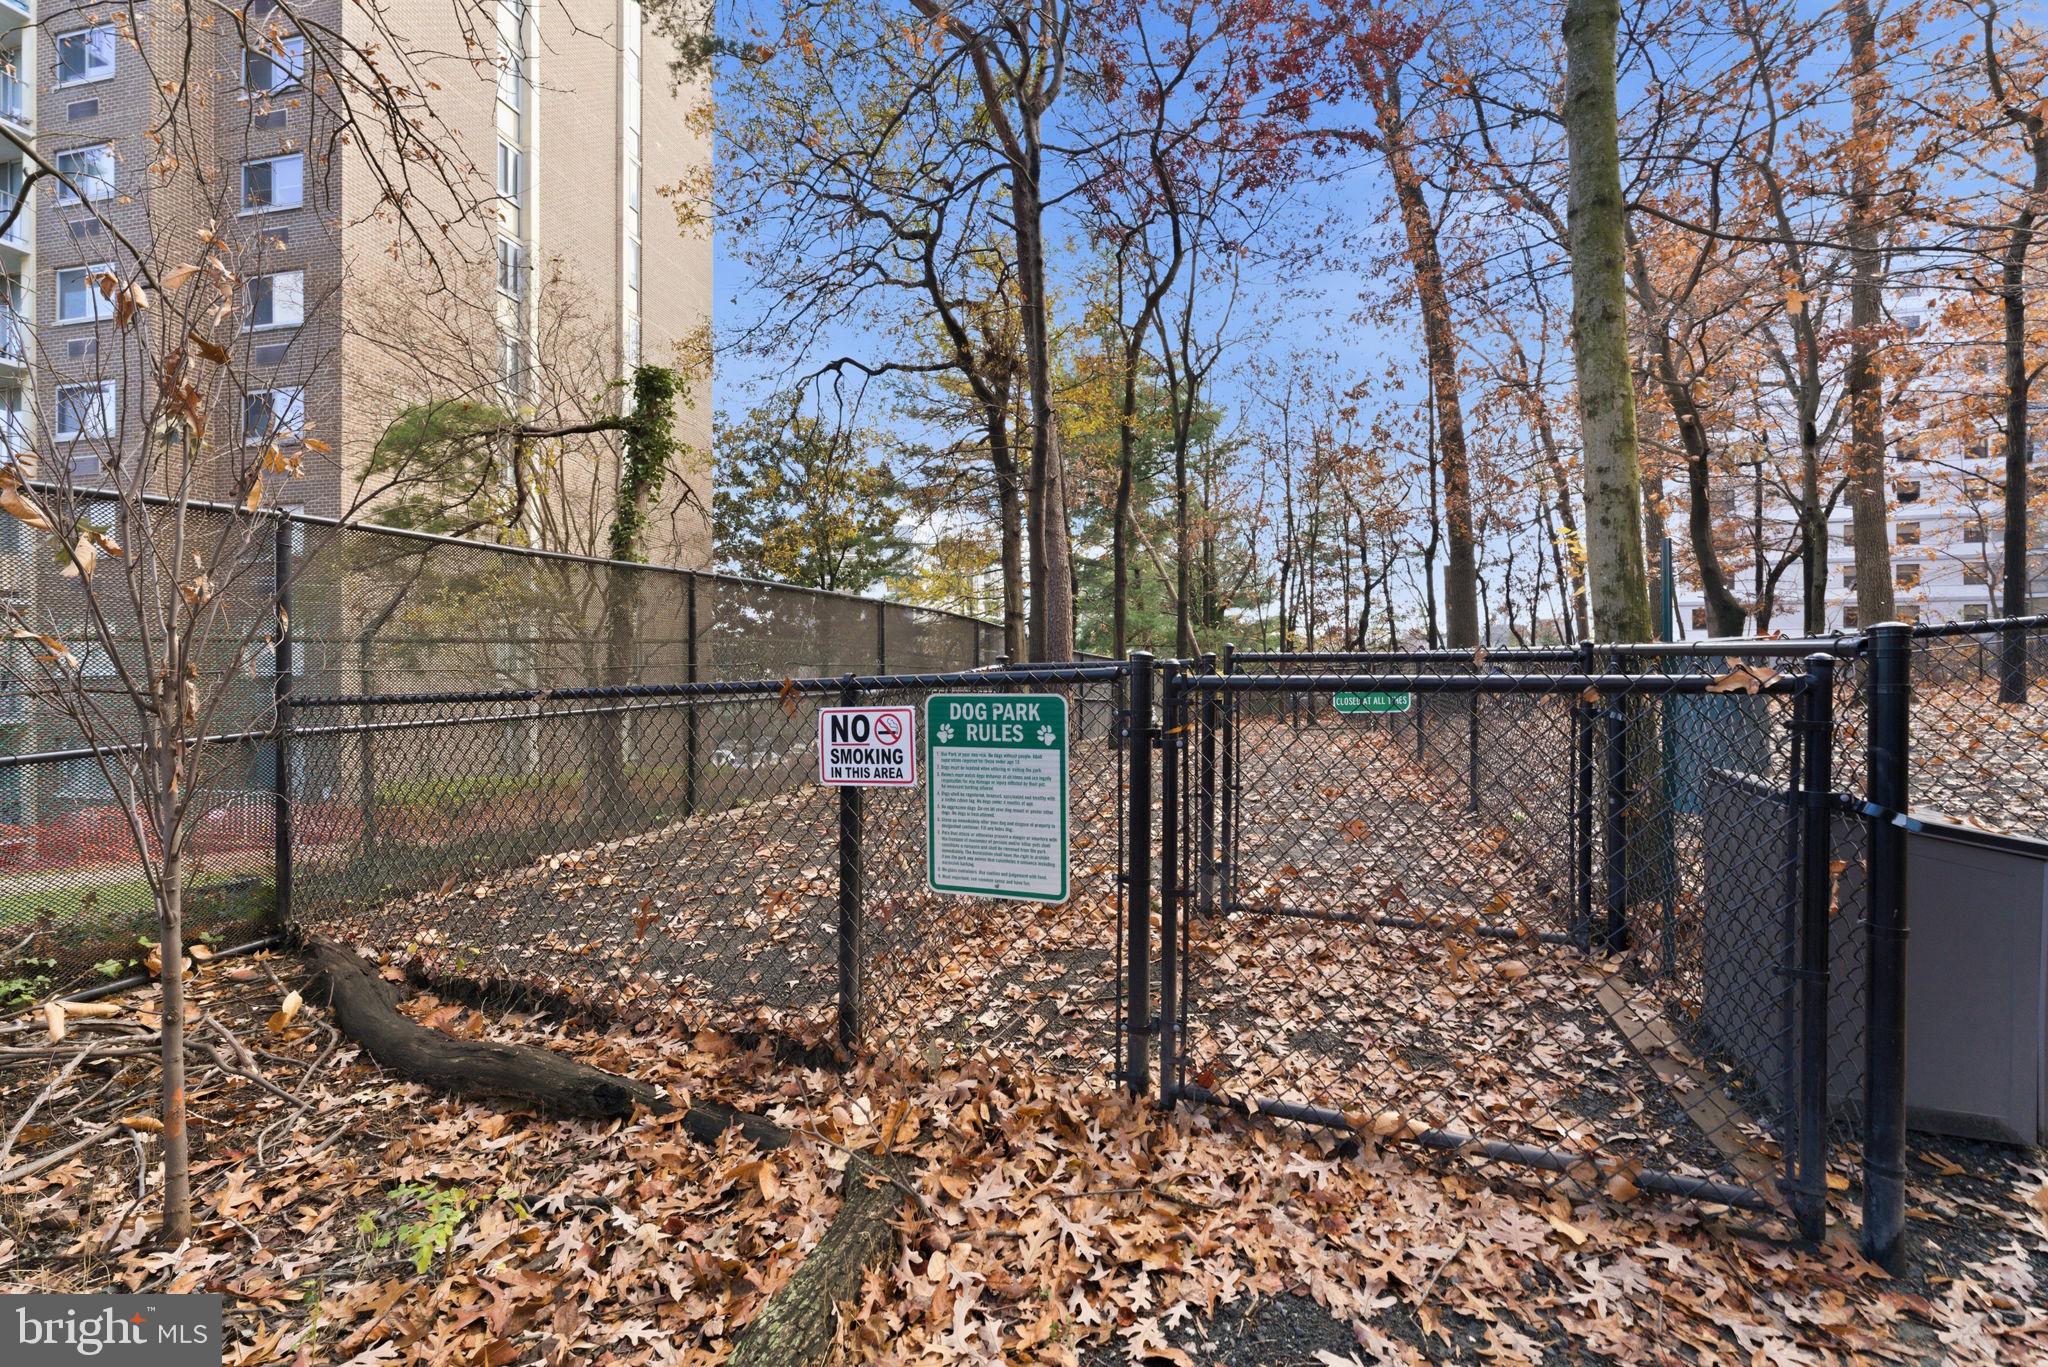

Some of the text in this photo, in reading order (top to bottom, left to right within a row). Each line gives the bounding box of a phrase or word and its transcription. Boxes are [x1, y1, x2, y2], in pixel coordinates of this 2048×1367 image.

[1363, 697, 1371, 705] AT
[1373, 696, 1386, 704] ALL
[1387, 696, 1408, 705] TES
[950, 702, 1041, 722] DOG PARK
[832, 714, 870, 742] NO
[966, 724, 1024, 742] RULES
[830, 748, 904, 764] SMOKING
[831, 767, 904, 779] IN THIS AREA
